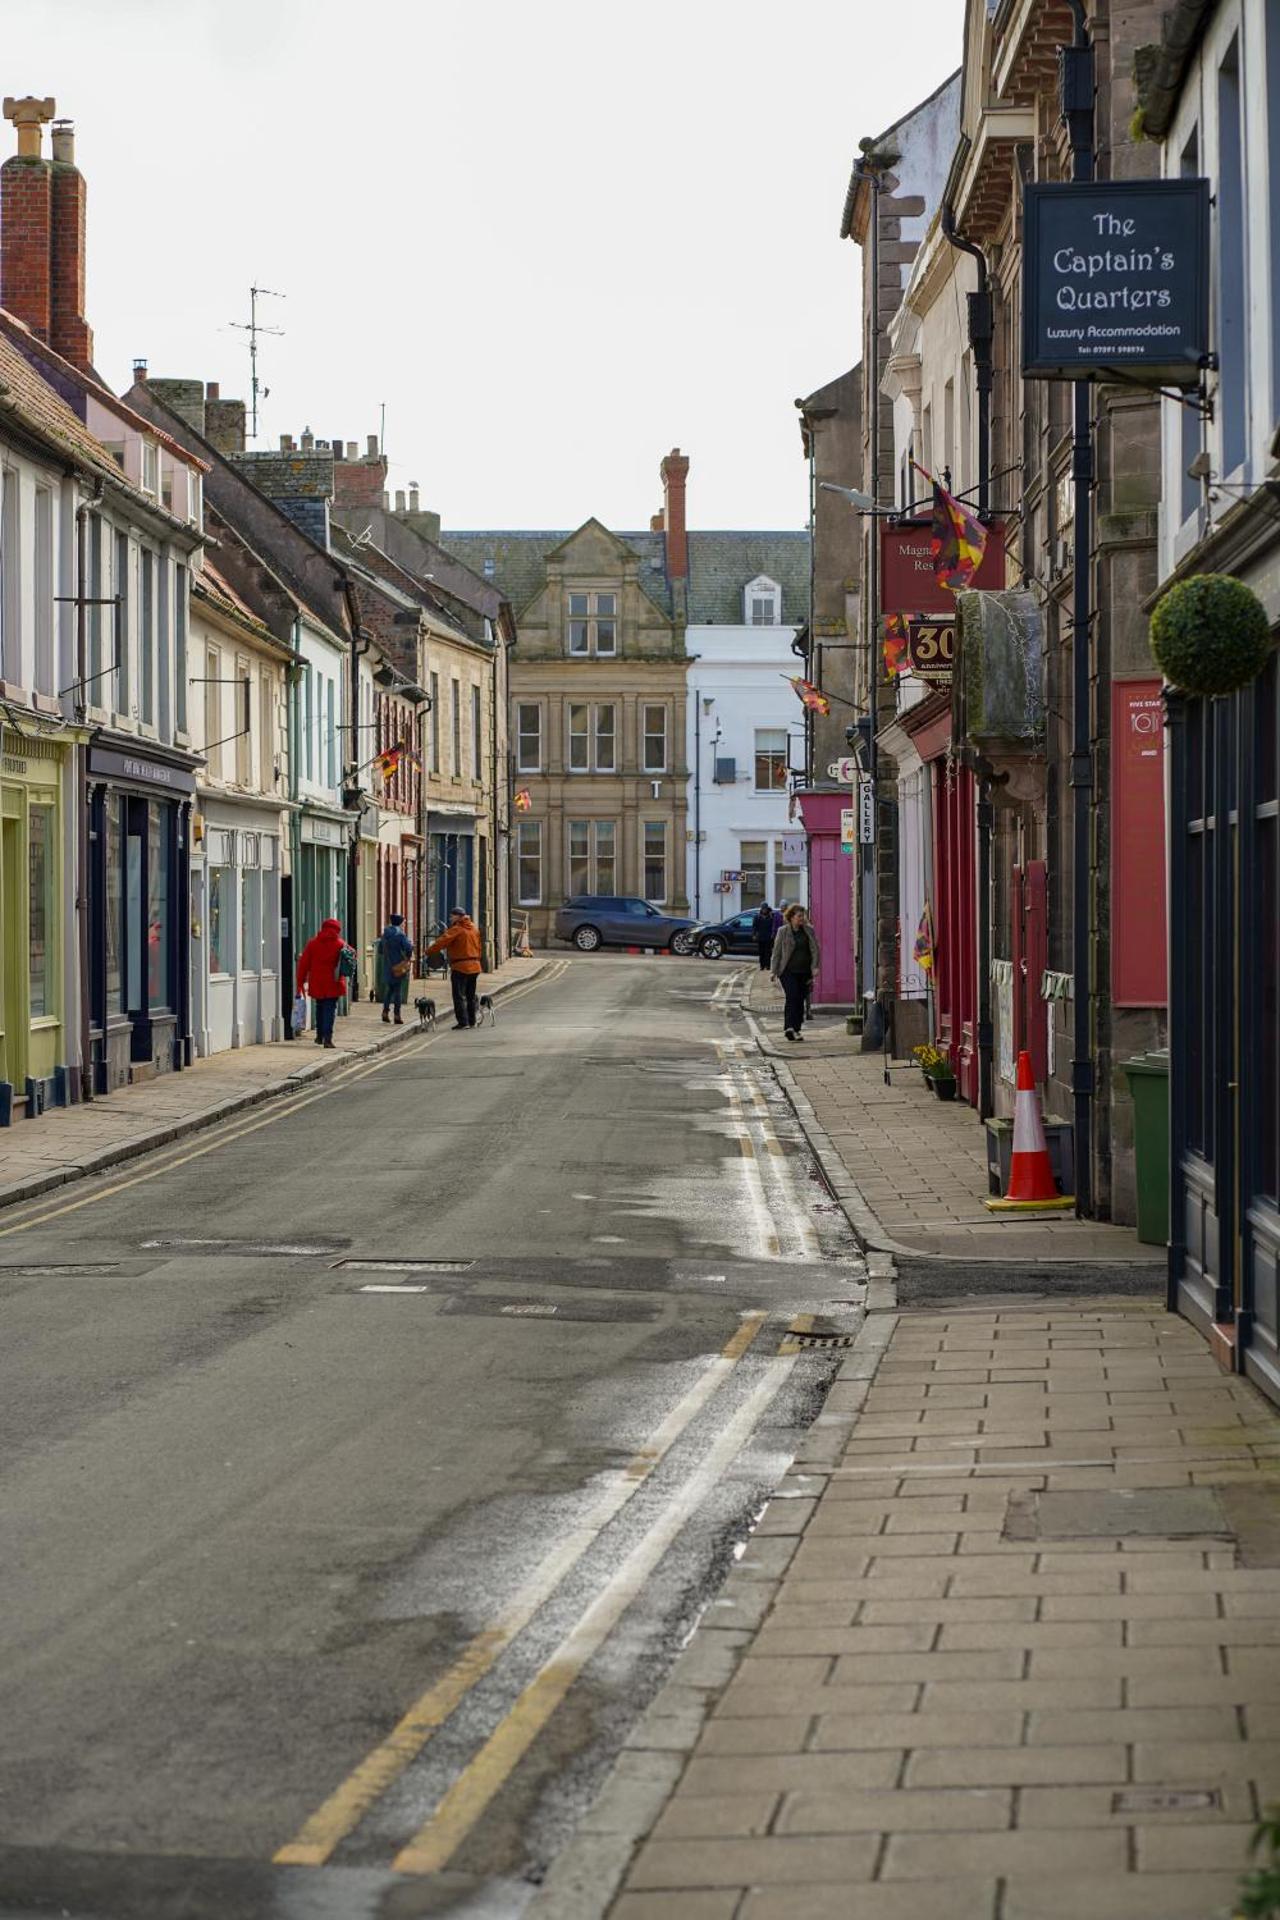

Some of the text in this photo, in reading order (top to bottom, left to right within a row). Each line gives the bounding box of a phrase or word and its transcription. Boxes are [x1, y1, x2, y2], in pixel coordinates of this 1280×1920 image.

[1093, 212, 1136, 237] The
[1053, 246, 1175, 278] Captain's
[1056, 286, 1171, 311] Quarters
[1047, 323, 1181, 340] Luxury Accommodation
[863, 785, 872, 842] GALLERY
